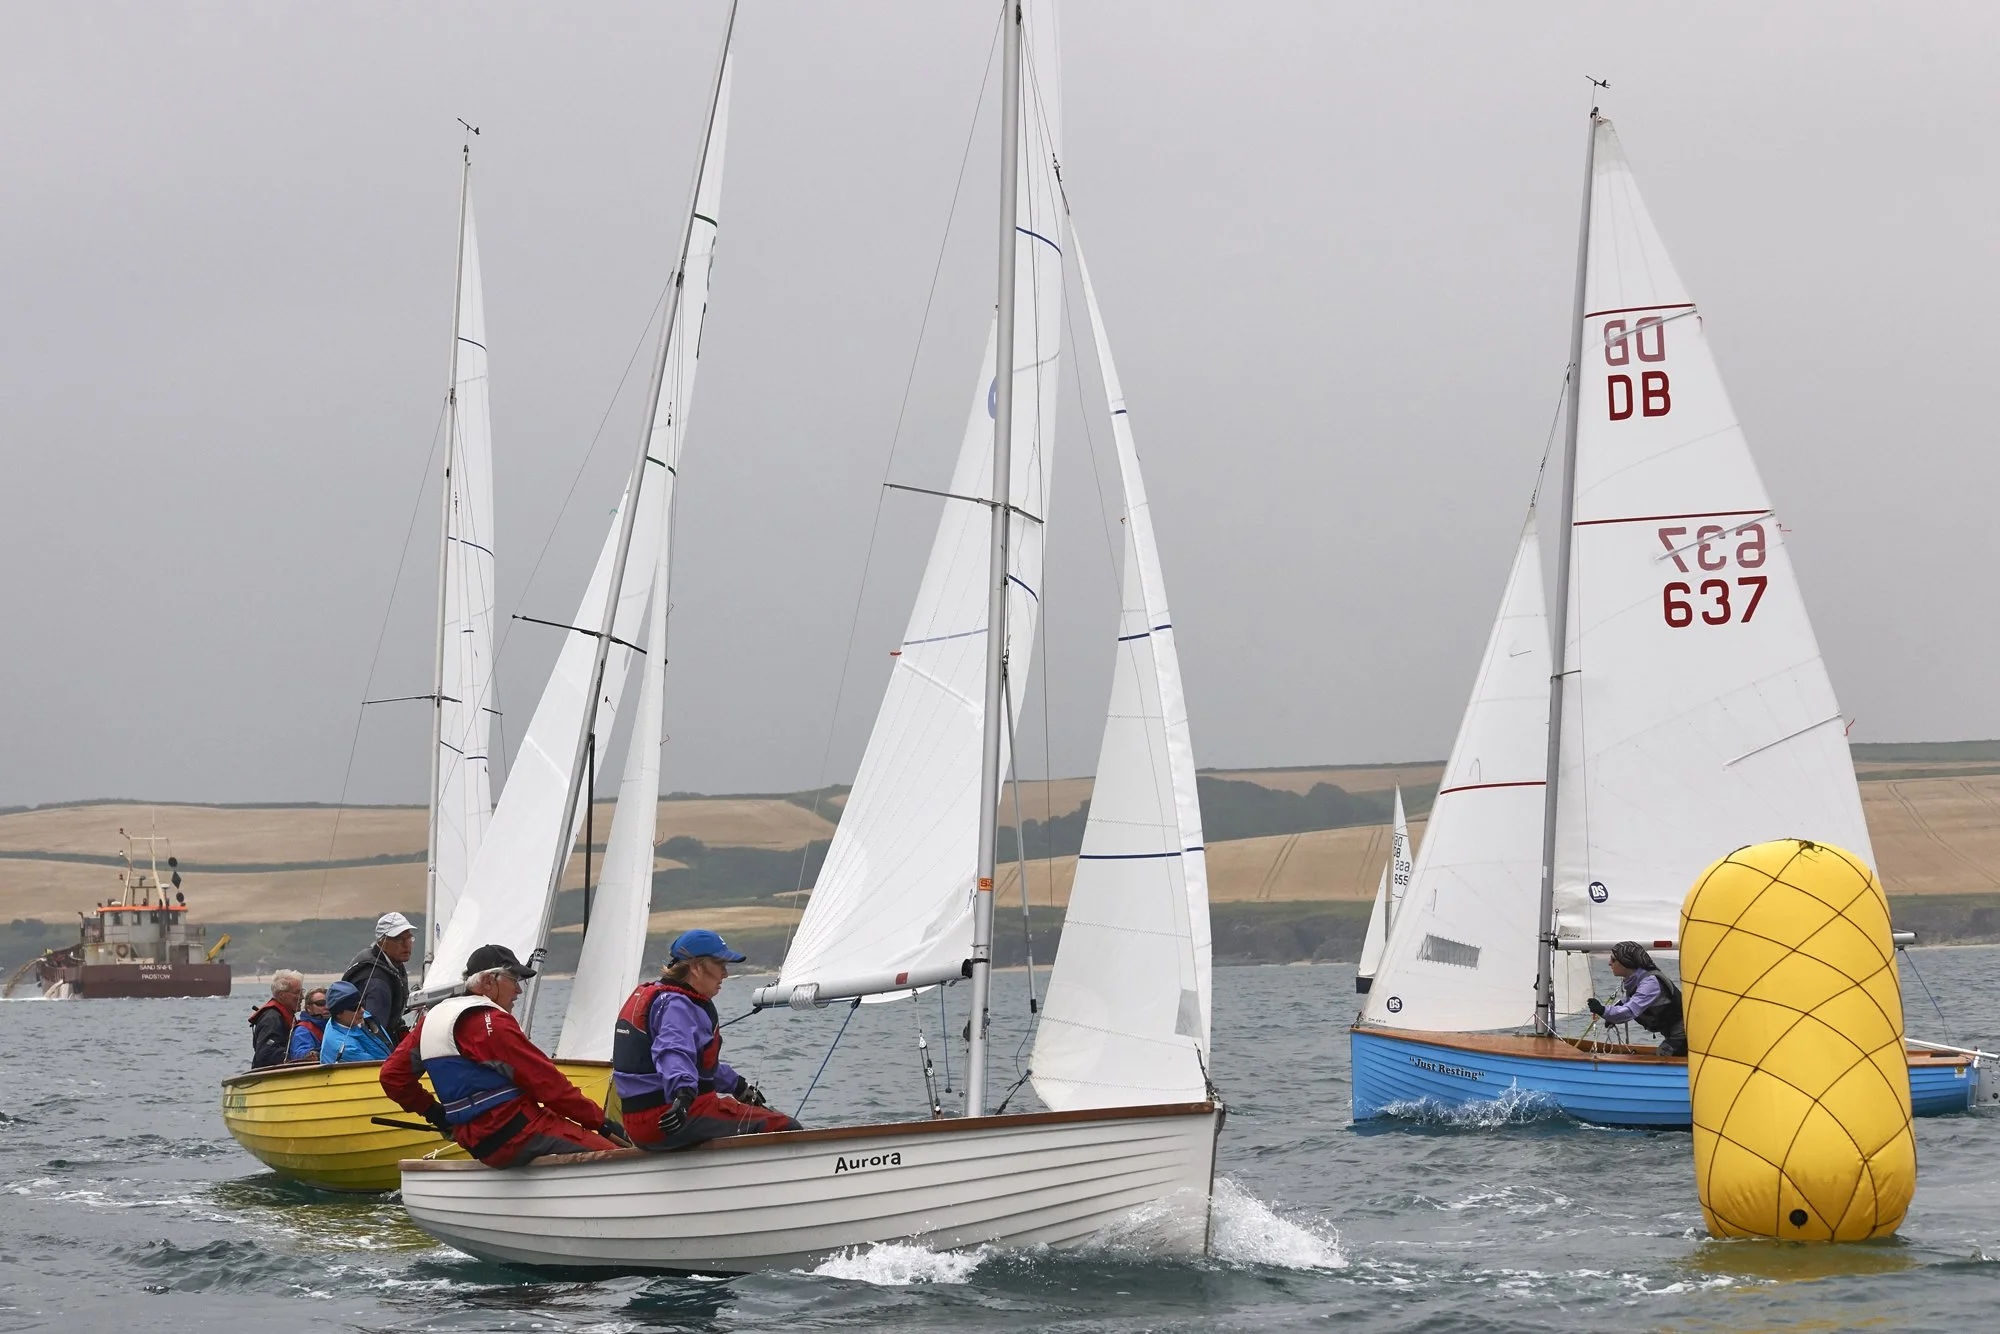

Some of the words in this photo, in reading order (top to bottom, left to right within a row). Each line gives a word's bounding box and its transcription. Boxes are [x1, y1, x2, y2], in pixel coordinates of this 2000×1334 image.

[1607, 370, 1671, 421] DB
[1663, 575, 1768, 628] 637
[834, 1152, 901, 1174] Aurora
